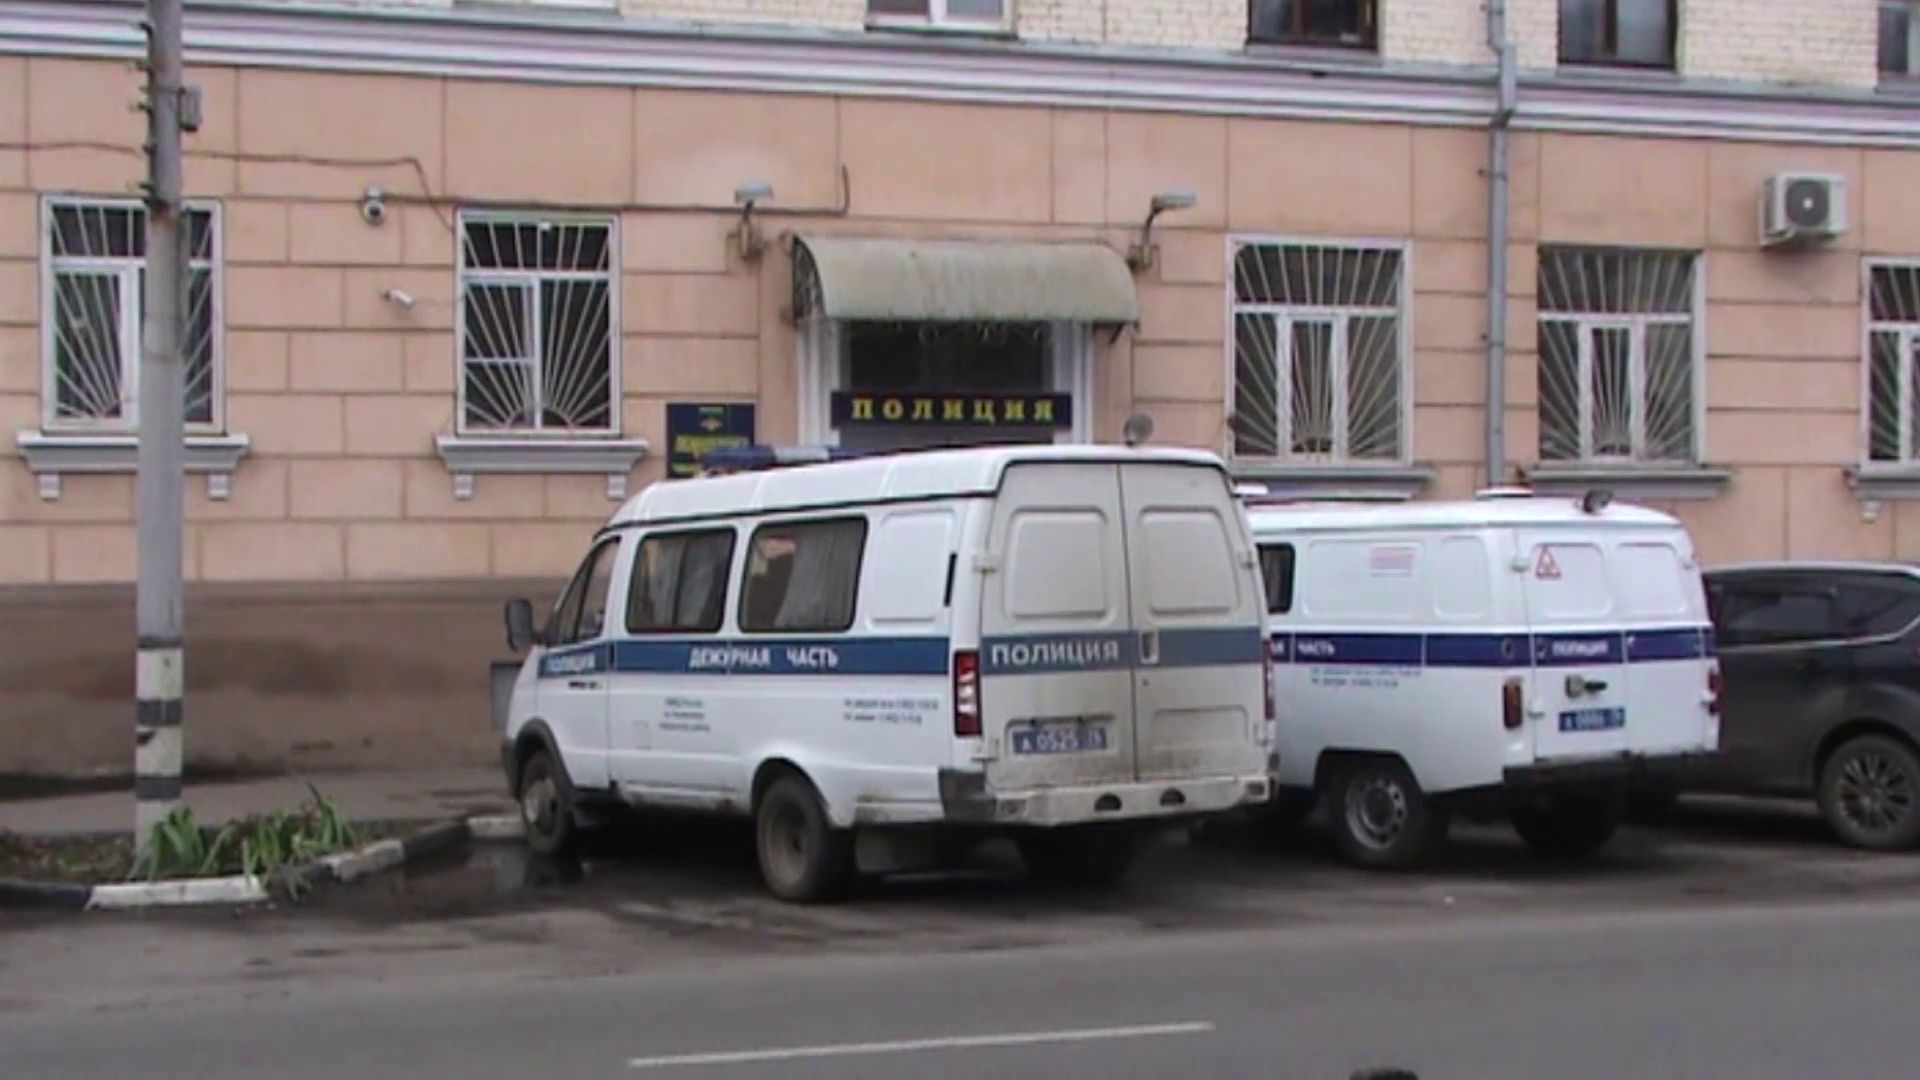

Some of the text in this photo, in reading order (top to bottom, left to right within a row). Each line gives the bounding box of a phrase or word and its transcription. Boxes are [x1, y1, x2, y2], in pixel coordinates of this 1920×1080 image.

[851, 398, 1054, 425] ПОЛИЦИЯ
[689, 646, 839, 669] ДЕЖУРНАЯ ЧАСТЬ
[991, 640, 1120, 665] ПОЛИЦИЯ
[1297, 639, 1335, 657] ЧАСТЬ
[1552, 640, 1609, 657] ПОЛИЦИЯ
